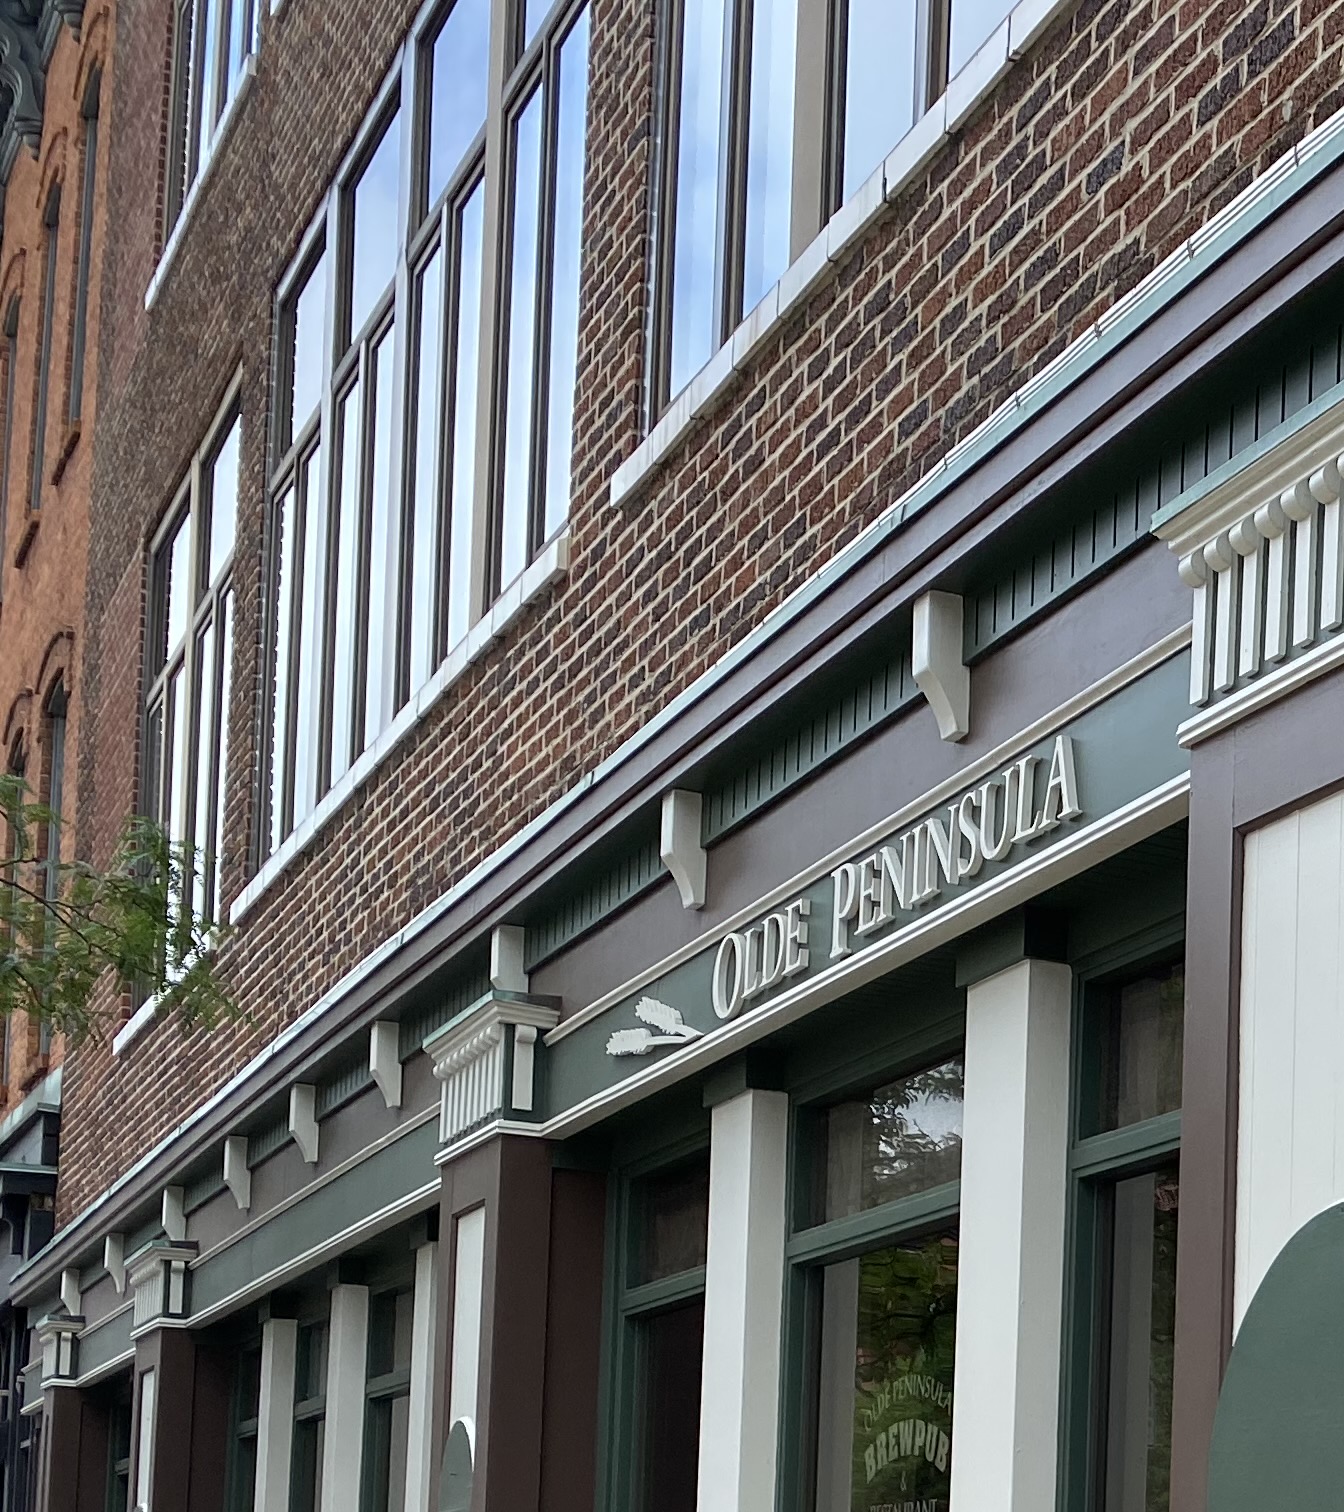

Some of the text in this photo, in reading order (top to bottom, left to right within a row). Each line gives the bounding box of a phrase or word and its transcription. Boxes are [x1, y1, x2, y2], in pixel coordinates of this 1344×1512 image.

[712, 735, 1084, 1019] OLDE PENINSULA
[893, 1374, 952, 1416] PENINSULA
[864, 1418, 949, 1484] BREWPUB
[900, 1470, 907, 1491] &
